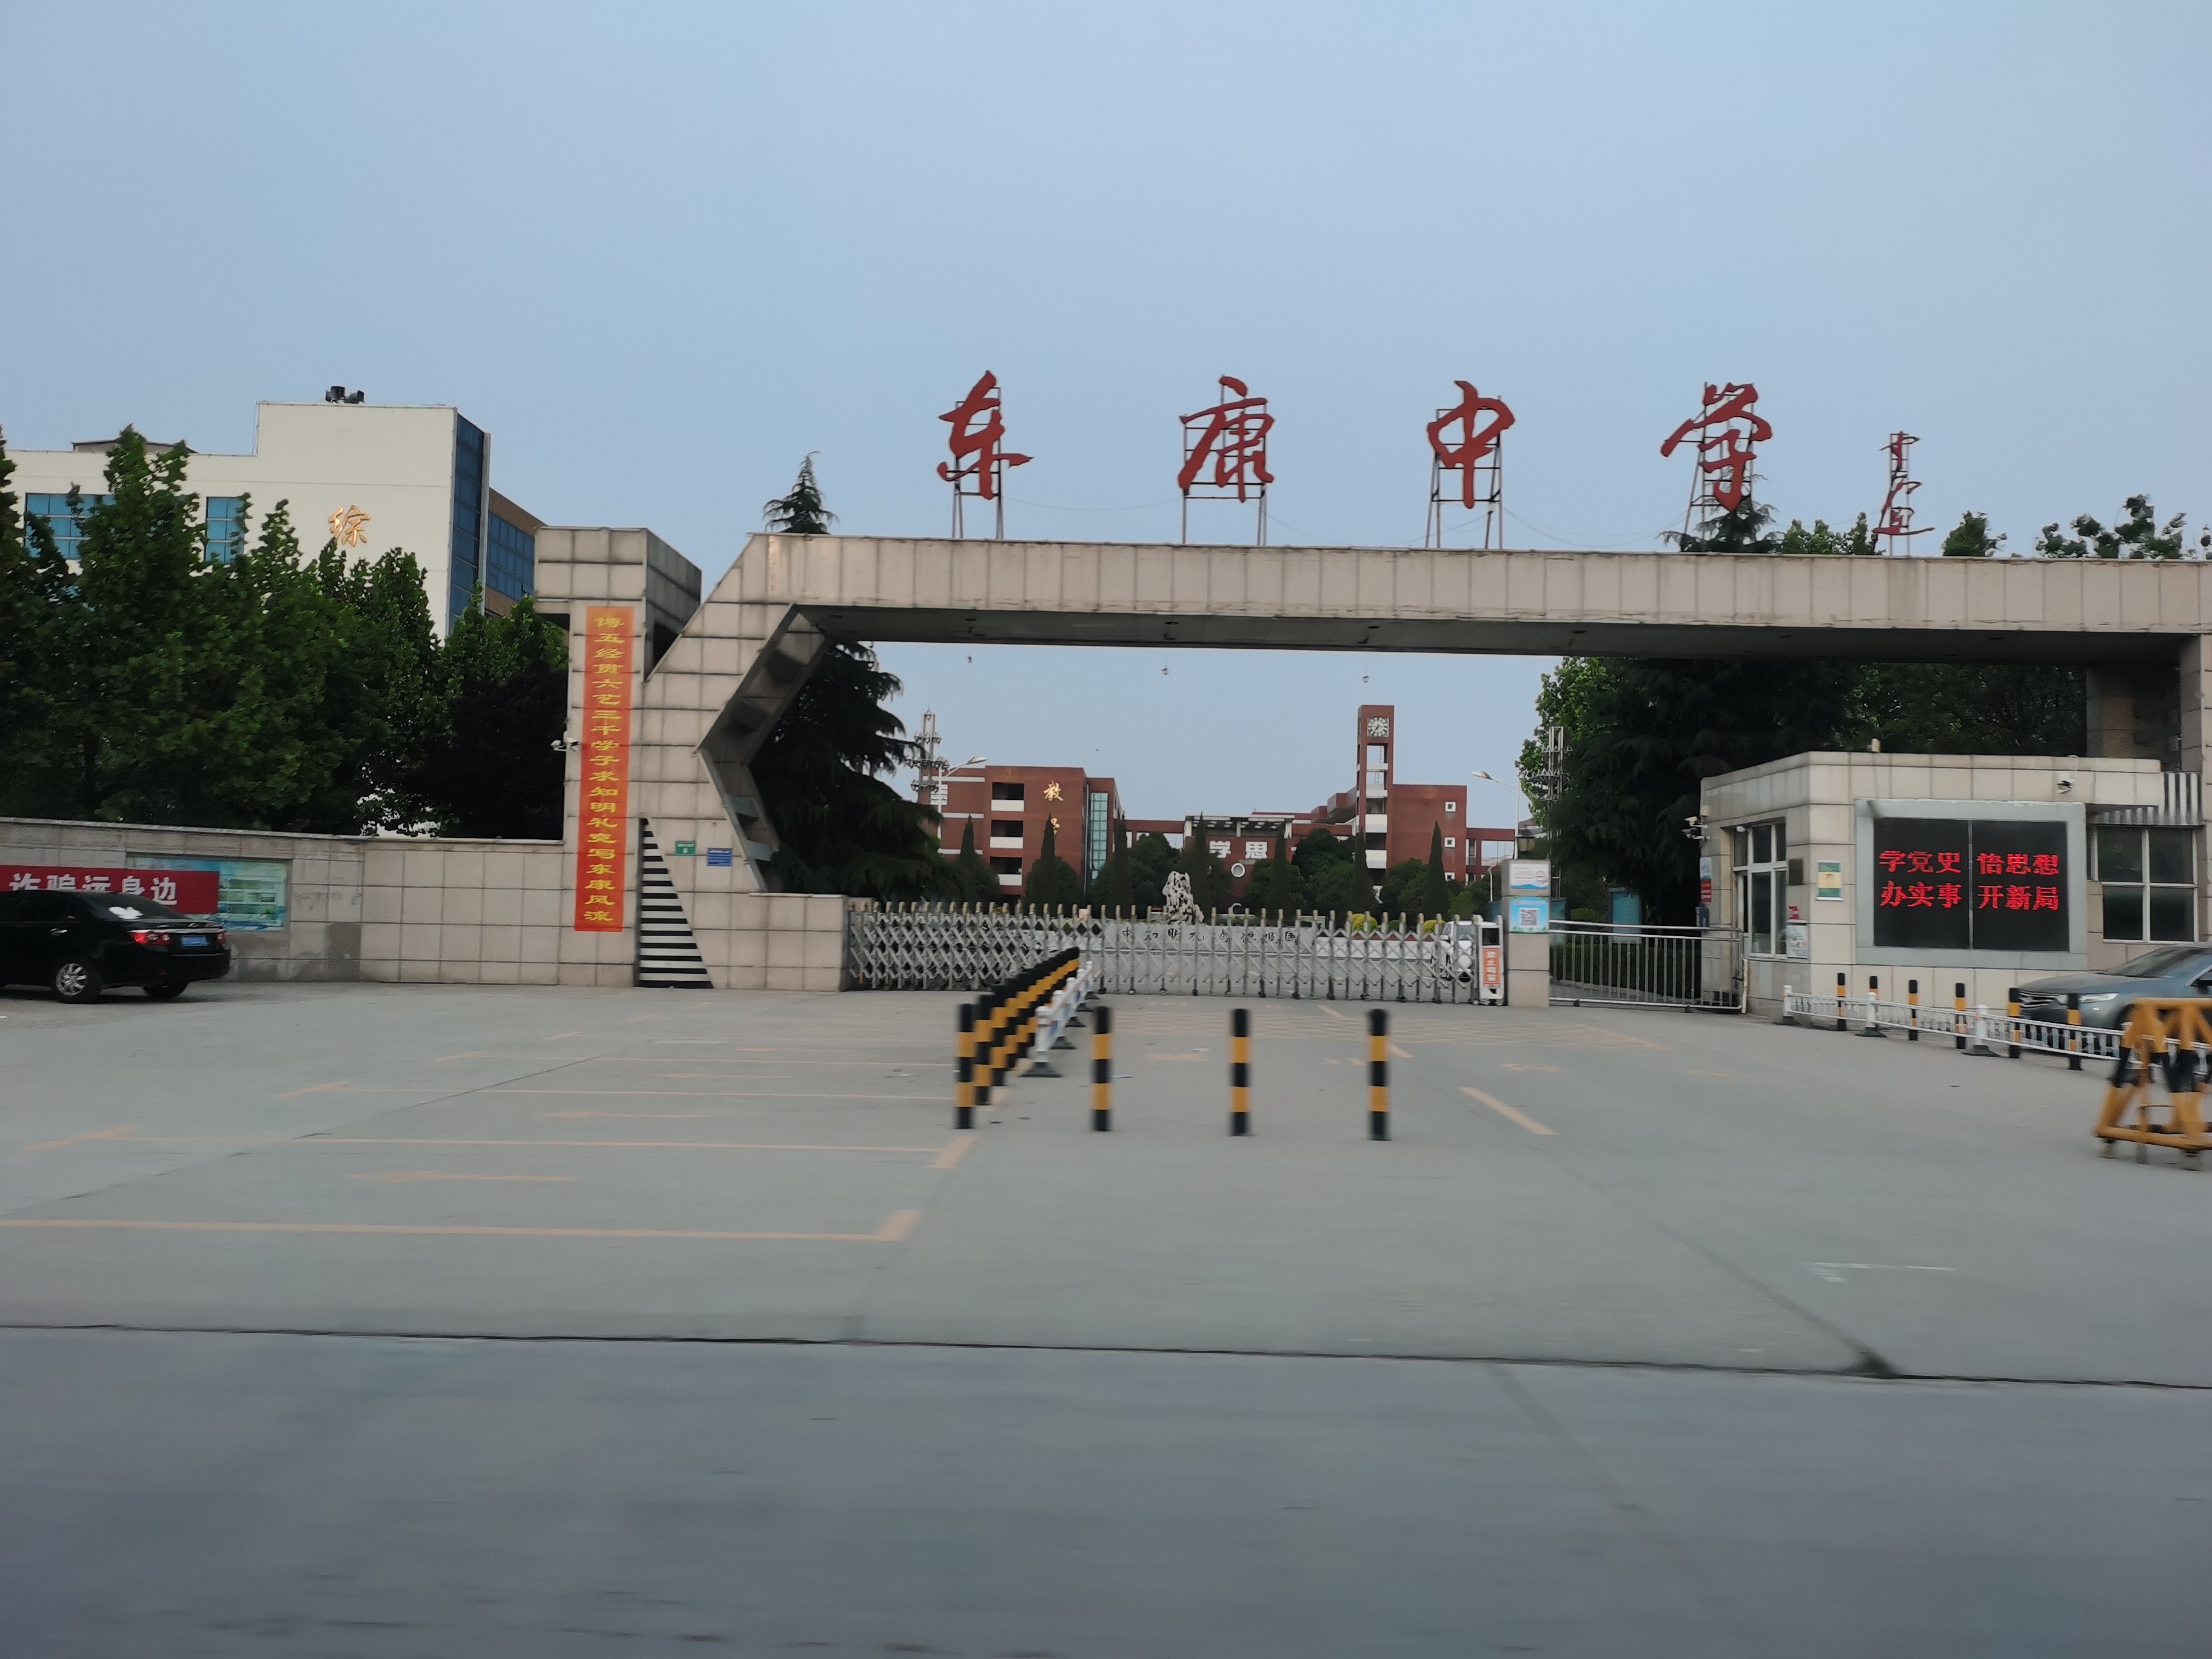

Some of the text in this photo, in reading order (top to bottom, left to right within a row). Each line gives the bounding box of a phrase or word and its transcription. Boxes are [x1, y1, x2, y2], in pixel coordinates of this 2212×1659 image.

[937, 369, 1773, 511] 东康中学
[1879, 850, 2059, 876] 学党史 悟思想
[1880, 880, 2059, 911] 办实事 开新局
